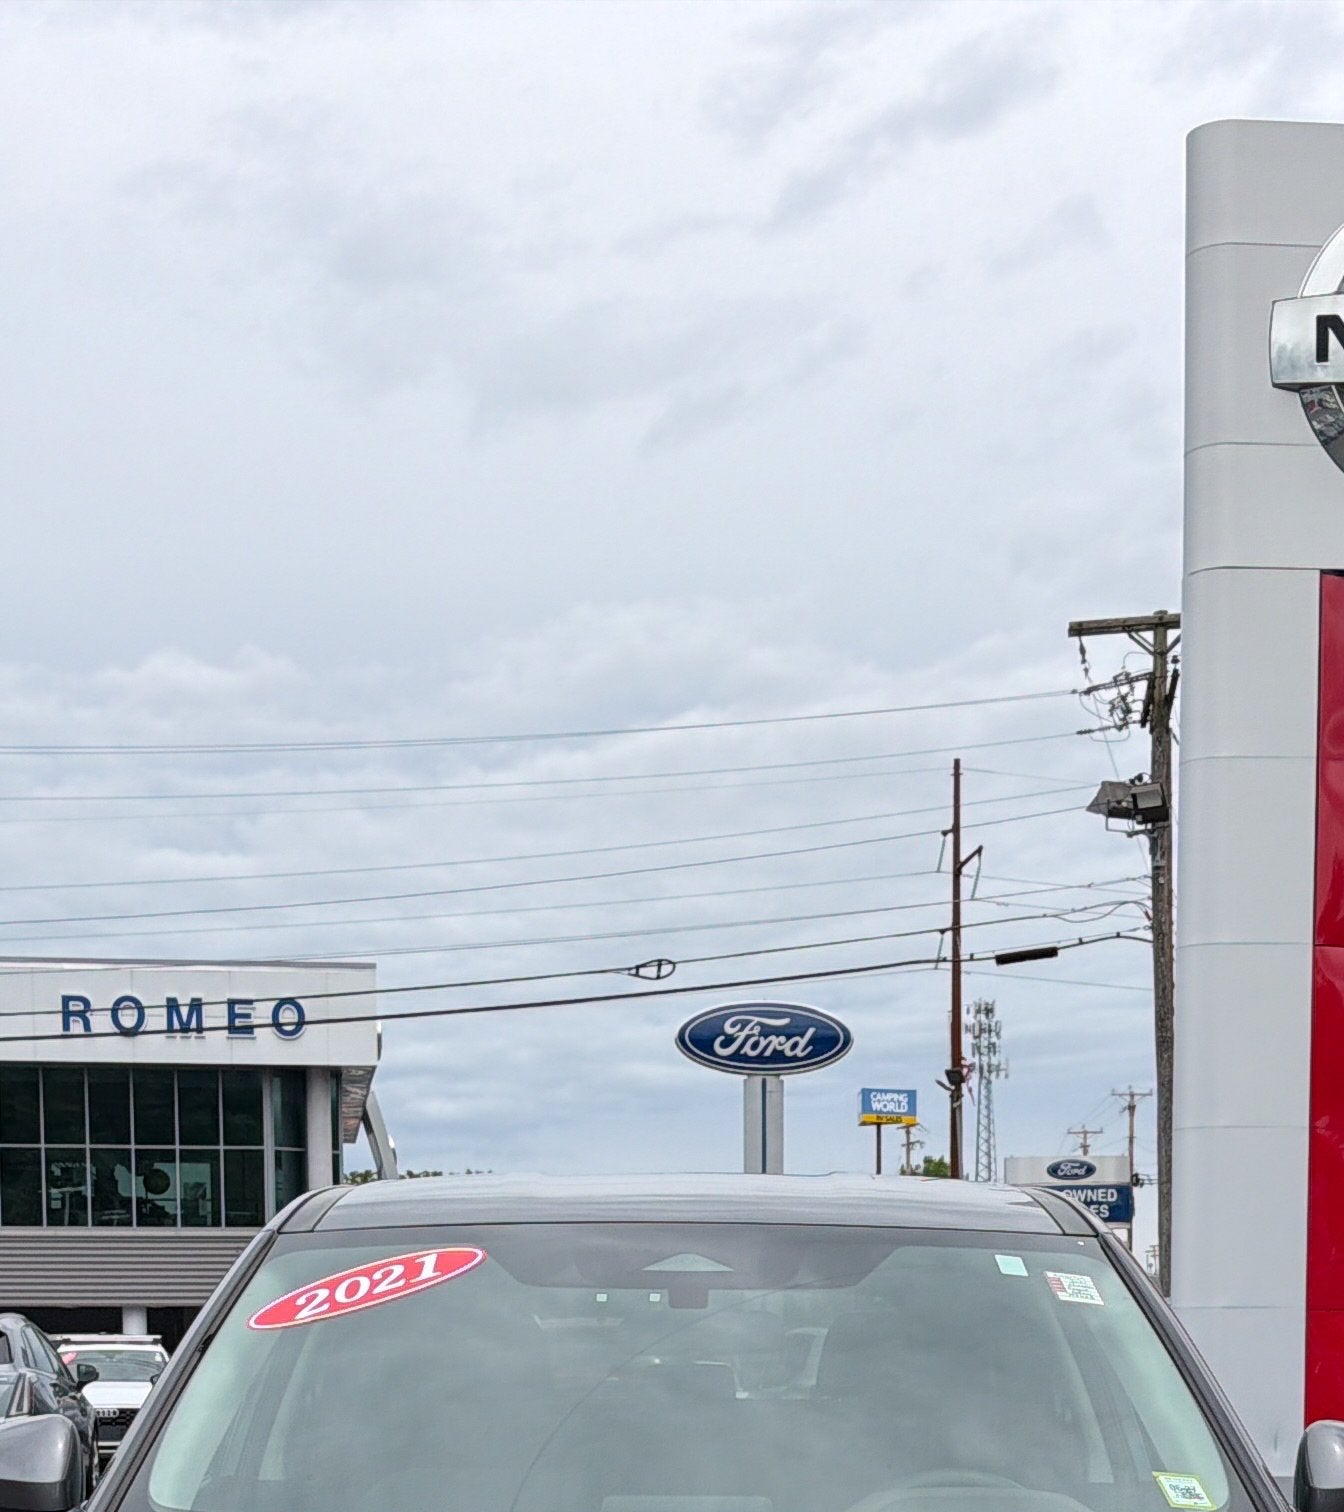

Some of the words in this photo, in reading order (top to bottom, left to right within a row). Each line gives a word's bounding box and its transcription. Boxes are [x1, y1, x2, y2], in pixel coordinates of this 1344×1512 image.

[60, 994, 306, 1037] ROMEO
[713, 1015, 816, 1058] Ford
[870, 1092, 908, 1102] CAMPING
[871, 1100, 908, 1112] WORLD
[1057, 1162, 1087, 1176] Ford
[294, 1253, 442, 1320] 2021
